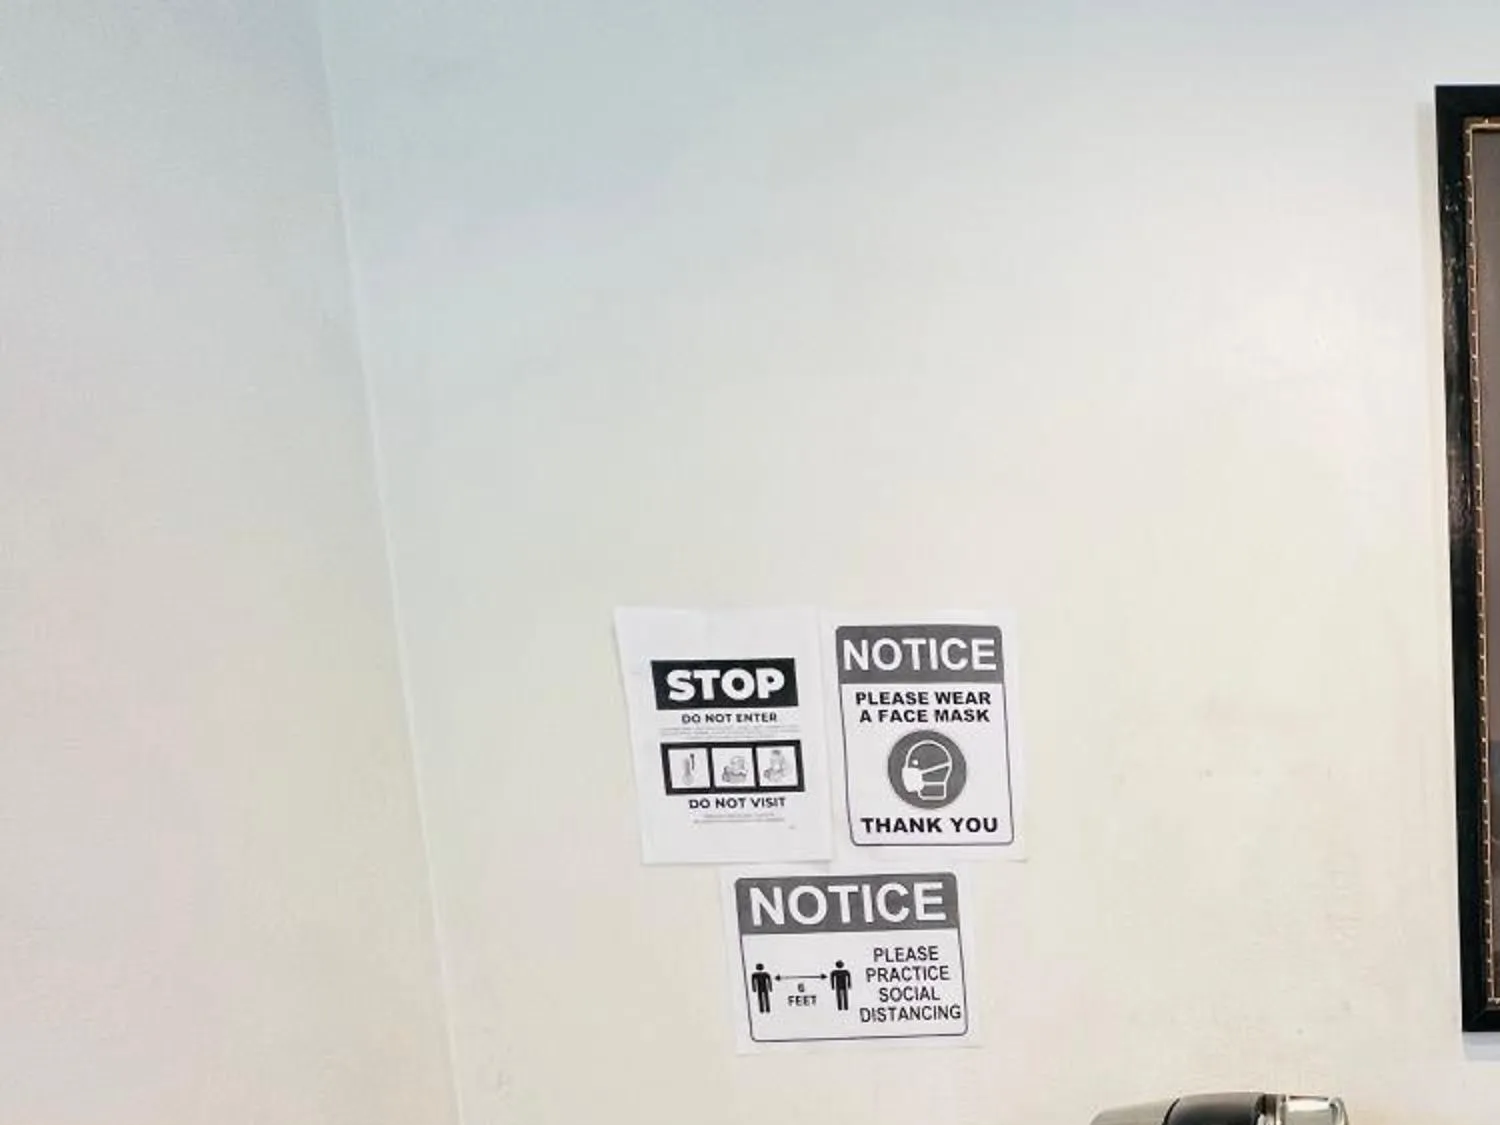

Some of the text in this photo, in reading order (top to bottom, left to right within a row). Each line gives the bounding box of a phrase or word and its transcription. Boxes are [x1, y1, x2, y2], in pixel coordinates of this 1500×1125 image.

[842, 637, 998, 672] NOTICE
[666, 667, 785, 702] STOP
[855, 691, 992, 706] PLEASE WEAR
[681, 712, 777, 724] DO NOT ENTER
[859, 708, 990, 723] A FACE MASK
[689, 797, 786, 809] DO NOT VISIT
[861, 817, 999, 834] THANK YOU
[749, 881, 947, 926] NOTICE
[873, 945, 939, 962] PLEASE
[865, 965, 950, 982] PRACTICE
[788, 995, 817, 1006] FEET
[878, 985, 941, 1001] SOCIAL
[859, 1004, 962, 1023] DISTANCING
